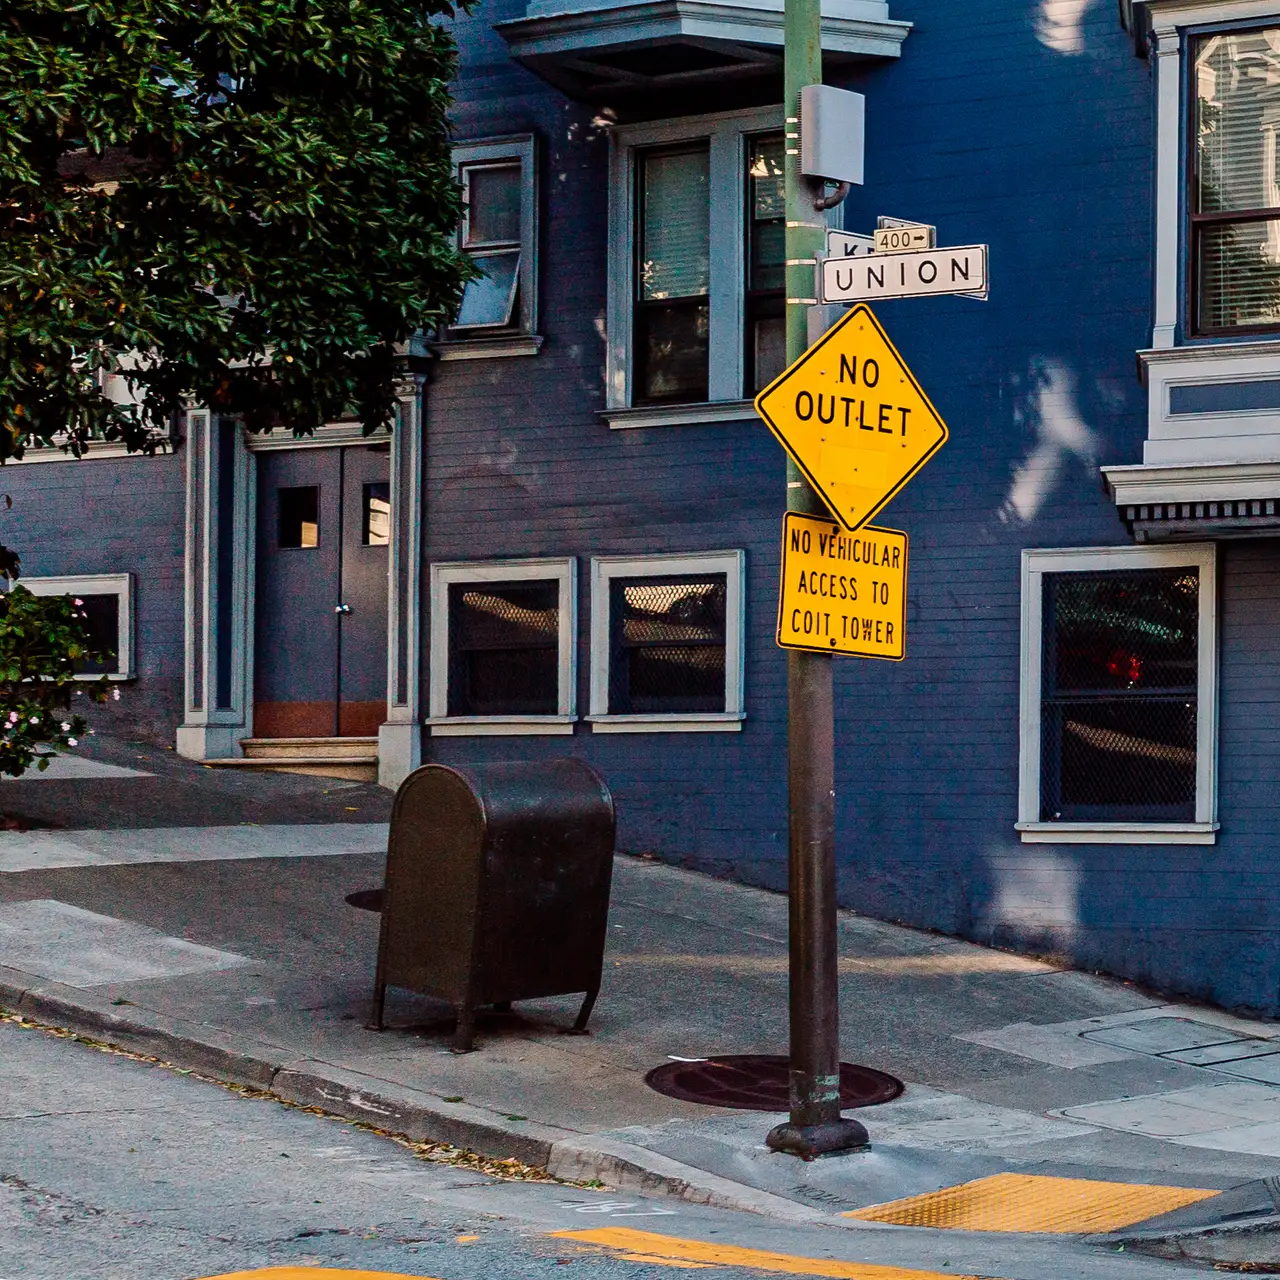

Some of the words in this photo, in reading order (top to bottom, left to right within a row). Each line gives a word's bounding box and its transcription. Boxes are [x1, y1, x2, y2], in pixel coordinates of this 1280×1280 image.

[880, 231, 910, 249] 400
[836, 257, 970, 291] UNION
[840, 353, 880, 388] NO
[795, 390, 912, 437] OUTLET
[791, 529, 811, 555] NO
[819, 533, 901, 569] VEHICULAR
[798, 570, 858, 602] ACCESS
[872, 581, 890, 606] TO
[791, 608, 831, 637] COIT
[842, 615, 894, 645] TOWER
